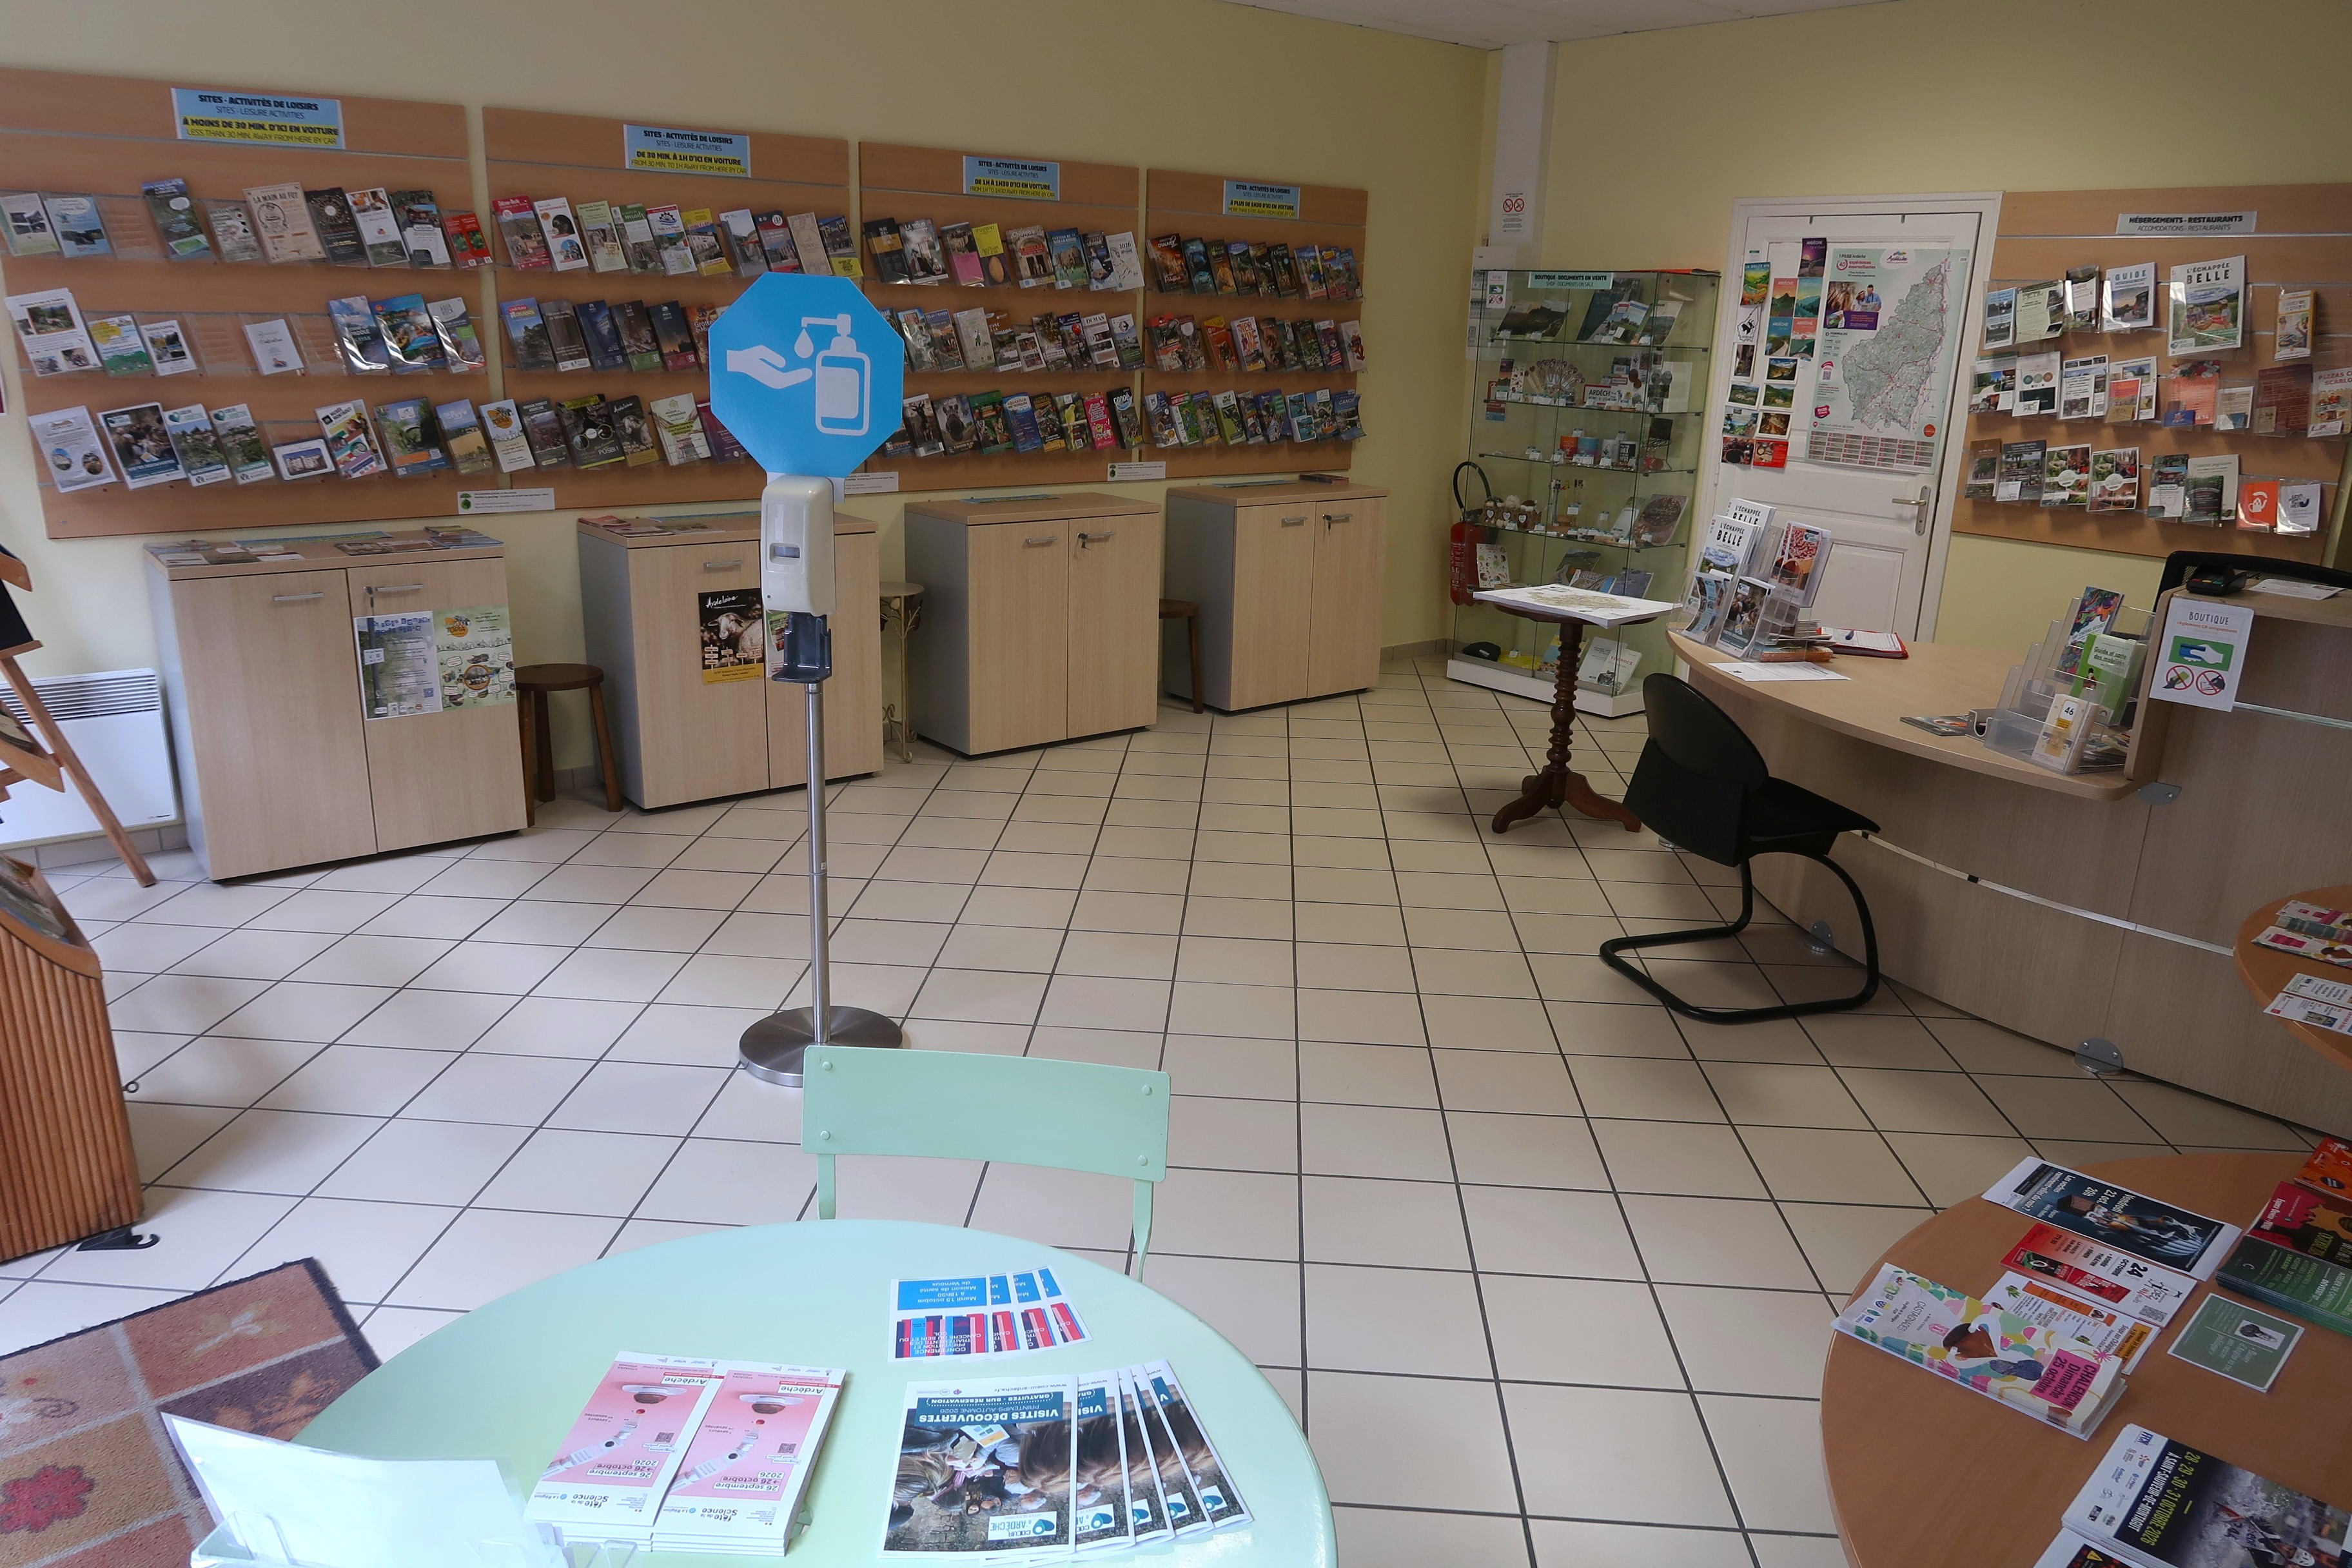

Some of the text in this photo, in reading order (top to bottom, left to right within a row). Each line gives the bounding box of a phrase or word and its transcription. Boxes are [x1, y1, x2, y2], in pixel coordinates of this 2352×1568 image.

[199, 94, 223, 104] SITES
[229, 96, 271, 107] ACTIVITÉS
[286, 101, 318, 110] LOISIRS
[217, 106, 304, 119] SITES LEISURE ACTIVITIES
[270, 122, 287, 132] D'ICI
[302, 125, 338, 135] VOITURE
[666, 132, 698, 141] ACTIVITÉS
[709, 135, 733, 144] LOISIRS
[696, 142, 722, 152] ACTIVITIES
[2129, 215, 2243, 224] HÉBERGEMENTS RESTAURANTS
[2187, 262, 2230, 273] L'ÉCHAPPÉE
[2115, 270, 2147, 281] GUIDE
[2187, 270, 2230, 284] BELLE
[1735, 505, 1761, 516] L'ÉCHAPPÉE
[1732, 513, 1759, 525] BELLE
[1720, 522, 1745, 534] L'ÉCHAPPÉE
[1717, 529, 1742, 547] BELLE
[706, 595, 738, 609] Ardelaine
[2189, 611, 2230, 625] BOUTIQUE
[2094, 646, 2108, 655] Guide
[2064, 707, 2074, 716] 46
[2082, 1186, 2098, 1197] 20h
[2104, 1189, 2117, 1197] 23
[2112, 1193, 2136, 1213] Vendredi
[2112, 1259, 2130, 1277] OCTOBRE
[2126, 1262, 2148, 1278] 24
[1897, 1300, 1926, 1332] CASTAGNADES
[2035, 1356, 2068, 1393] 25 octobre
[2049, 1363, 2080, 1398] Dimanche
[664, 1377, 707, 1386] Ardèche
[2062, 1364, 2097, 1410] CHALENCON
[960, 1404, 1039, 1413] PRINTEMPS-AUTOMNE
[919, 1409, 1059, 1423] VISITES DÉCOUVERTES
[573, 1494, 609, 1502] Science
[2128, 1456, 2178, 1533] SAINT-SAUVEUR-DE-MONTAGUT
[2141, 1451, 2201, 1545] 28 29 30 31 OCTOBRE 2026
[701, 1507, 738, 1516] Science
